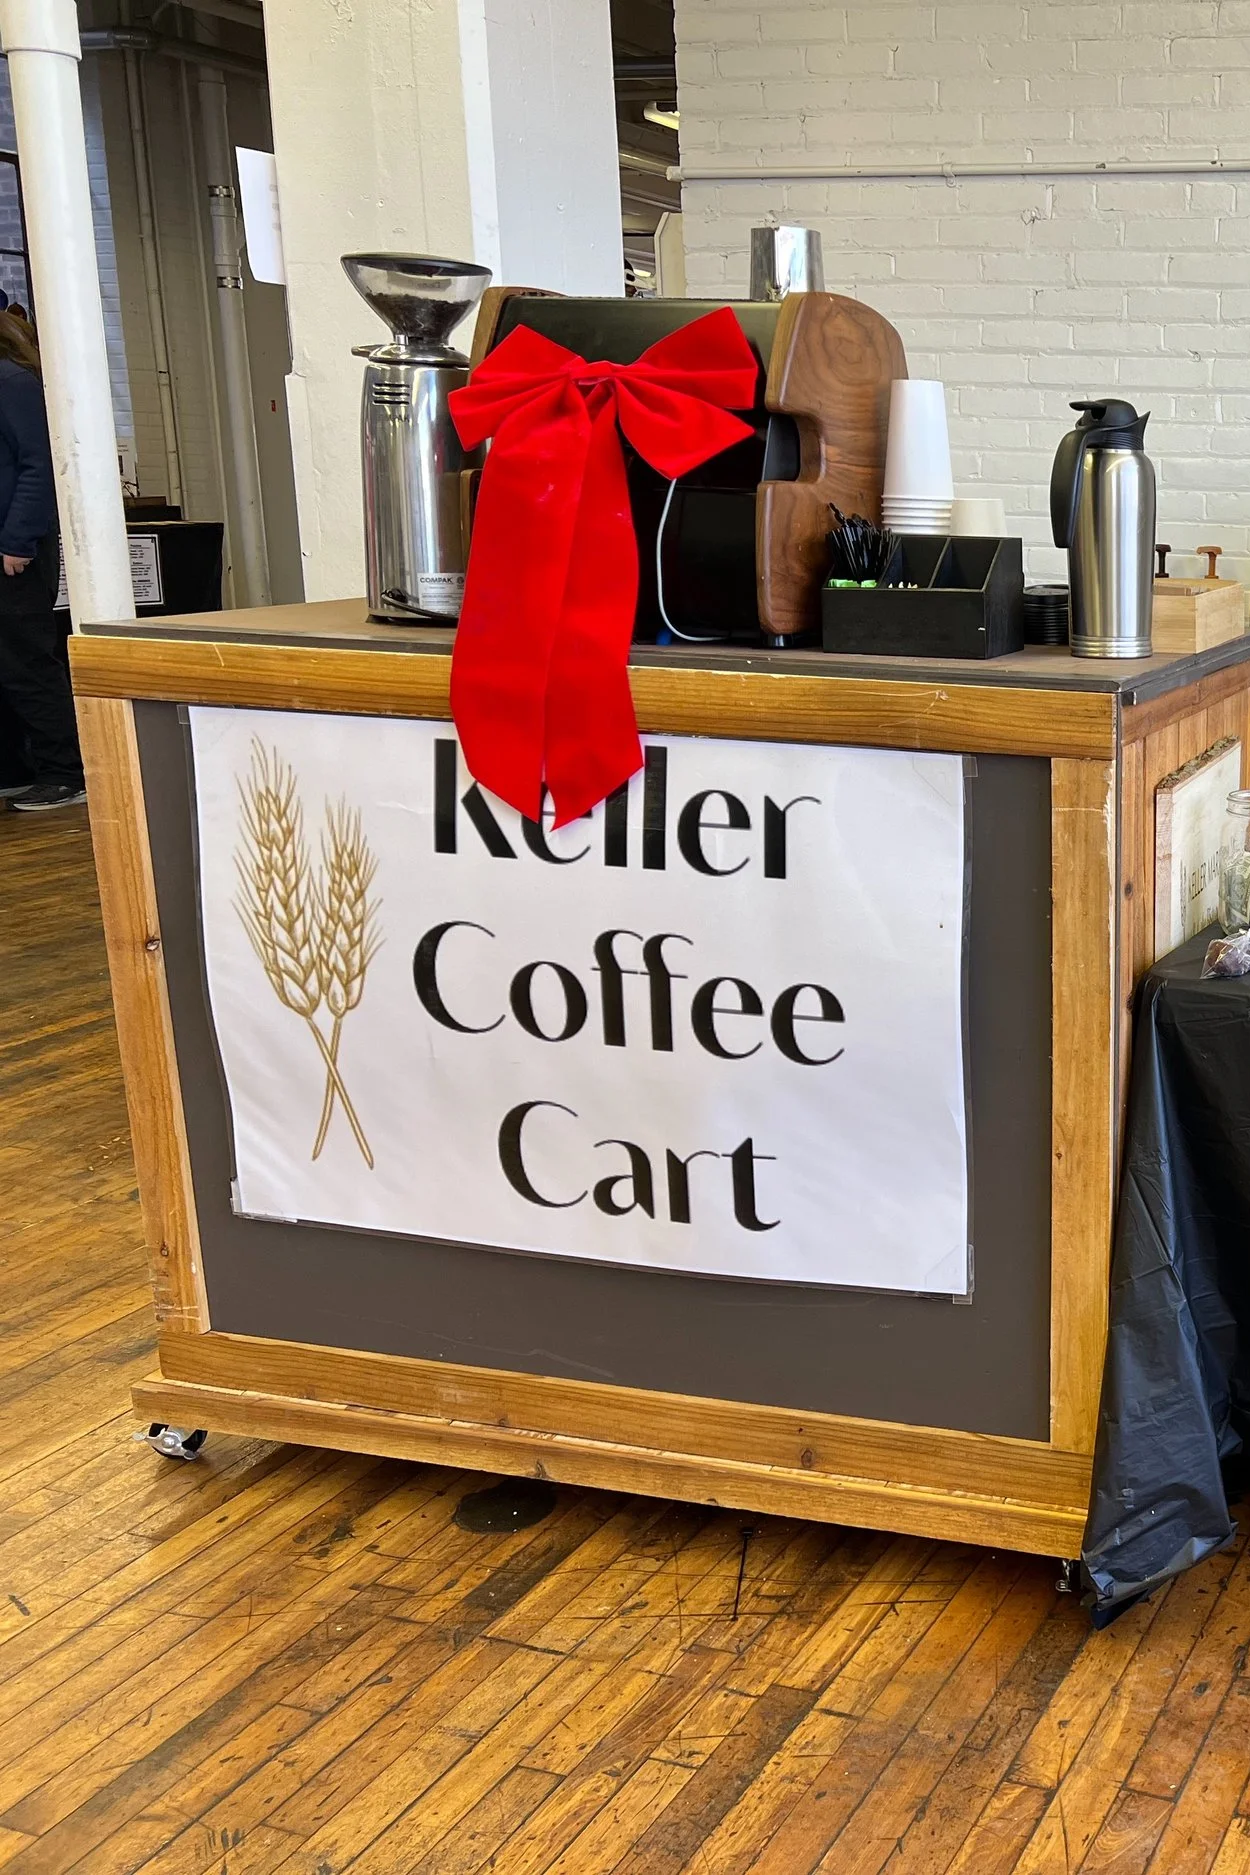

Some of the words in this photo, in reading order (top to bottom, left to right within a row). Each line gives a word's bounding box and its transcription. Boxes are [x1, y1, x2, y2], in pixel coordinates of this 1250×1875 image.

[434, 738, 822, 880] Keller
[412, 920, 846, 1067] Coffee
[497, 1100, 782, 1233] Cart
